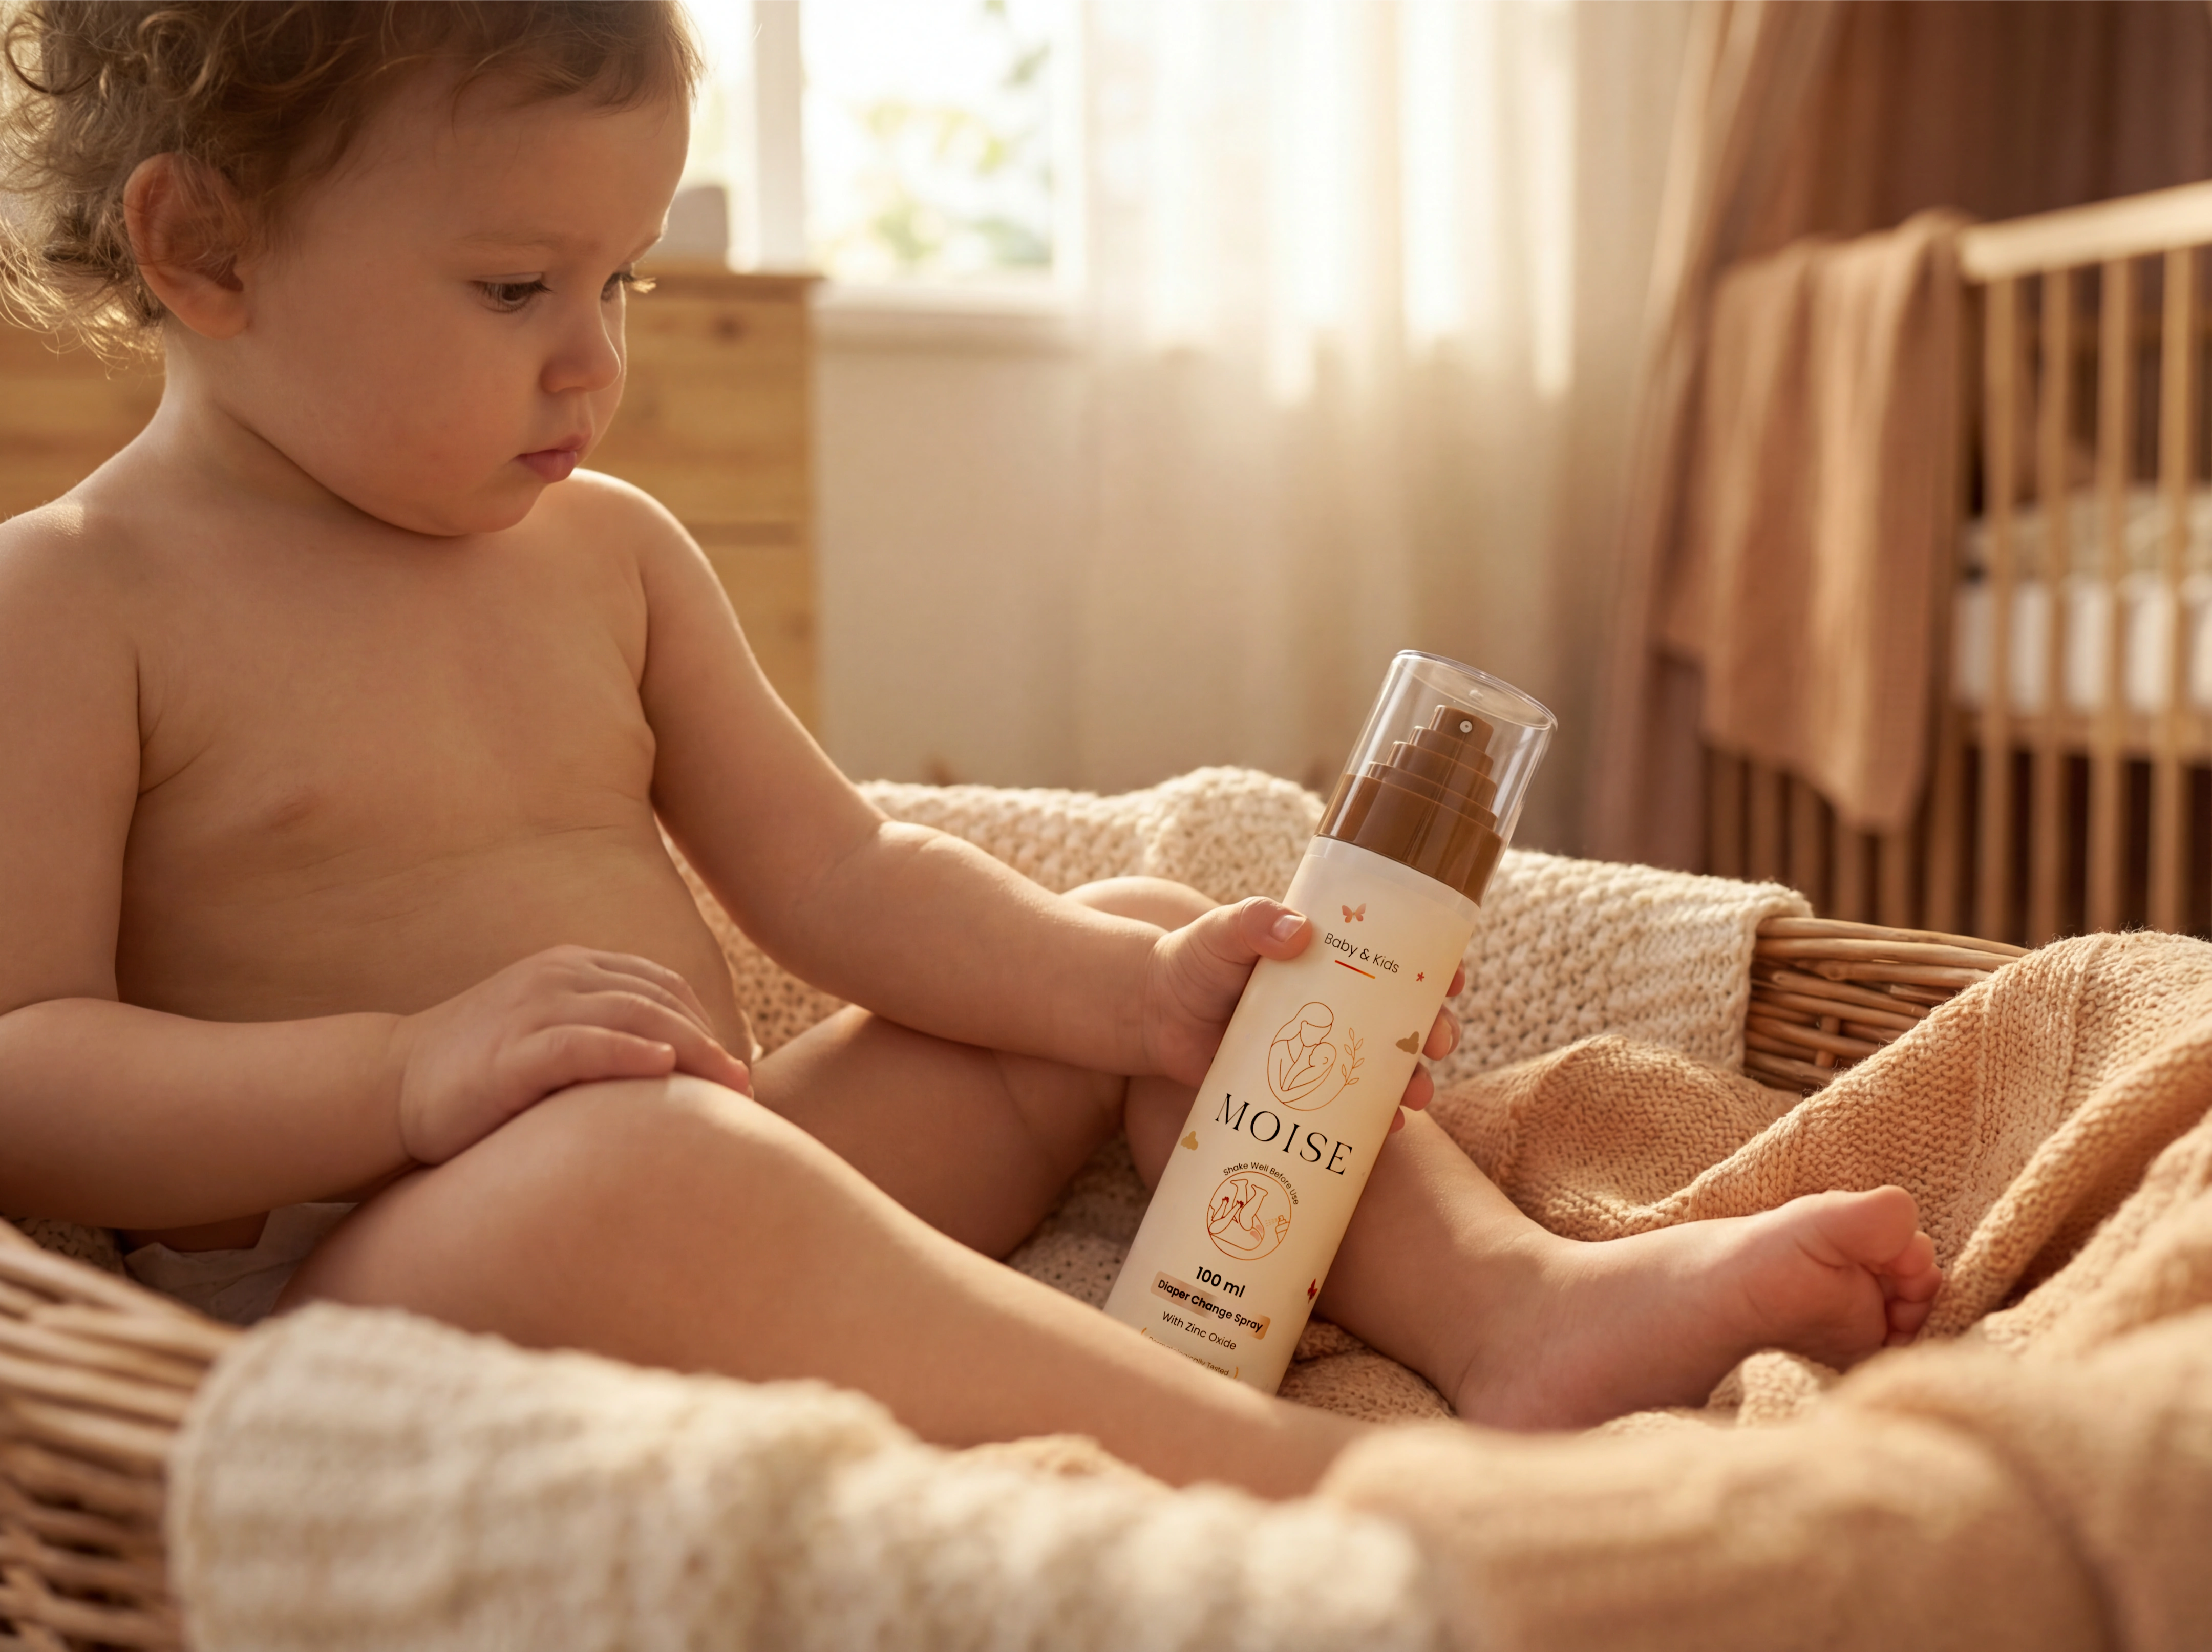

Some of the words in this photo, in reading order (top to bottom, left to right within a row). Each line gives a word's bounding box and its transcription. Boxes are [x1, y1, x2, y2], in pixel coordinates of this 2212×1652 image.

[1324, 933, 1358, 957] Baby
[1359, 948, 1370, 961] &
[1373, 954, 1399, 973] Kids
[1215, 1093, 1353, 1175] MOISE
[1223, 1163, 1248, 1175] Shake
[1251, 1162, 1269, 1172] Well
[1269, 1168, 1291, 1189] Before
[1290, 1189, 1299, 1205] Use
[1196, 1266, 1222, 1286] 100
[1223, 1281, 1246, 1298] ml
[1158, 1279, 1190, 1300] Diaper
[1191, 1295, 1232, 1319] Change
[1234, 1314, 1263, 1333] Spray
[1163, 1311, 1183, 1328] With
[1185, 1322, 1206, 1338] Zinc
[1209, 1333, 1236, 1350] Oxide
[1207, 1362, 1229, 1376] Tested
